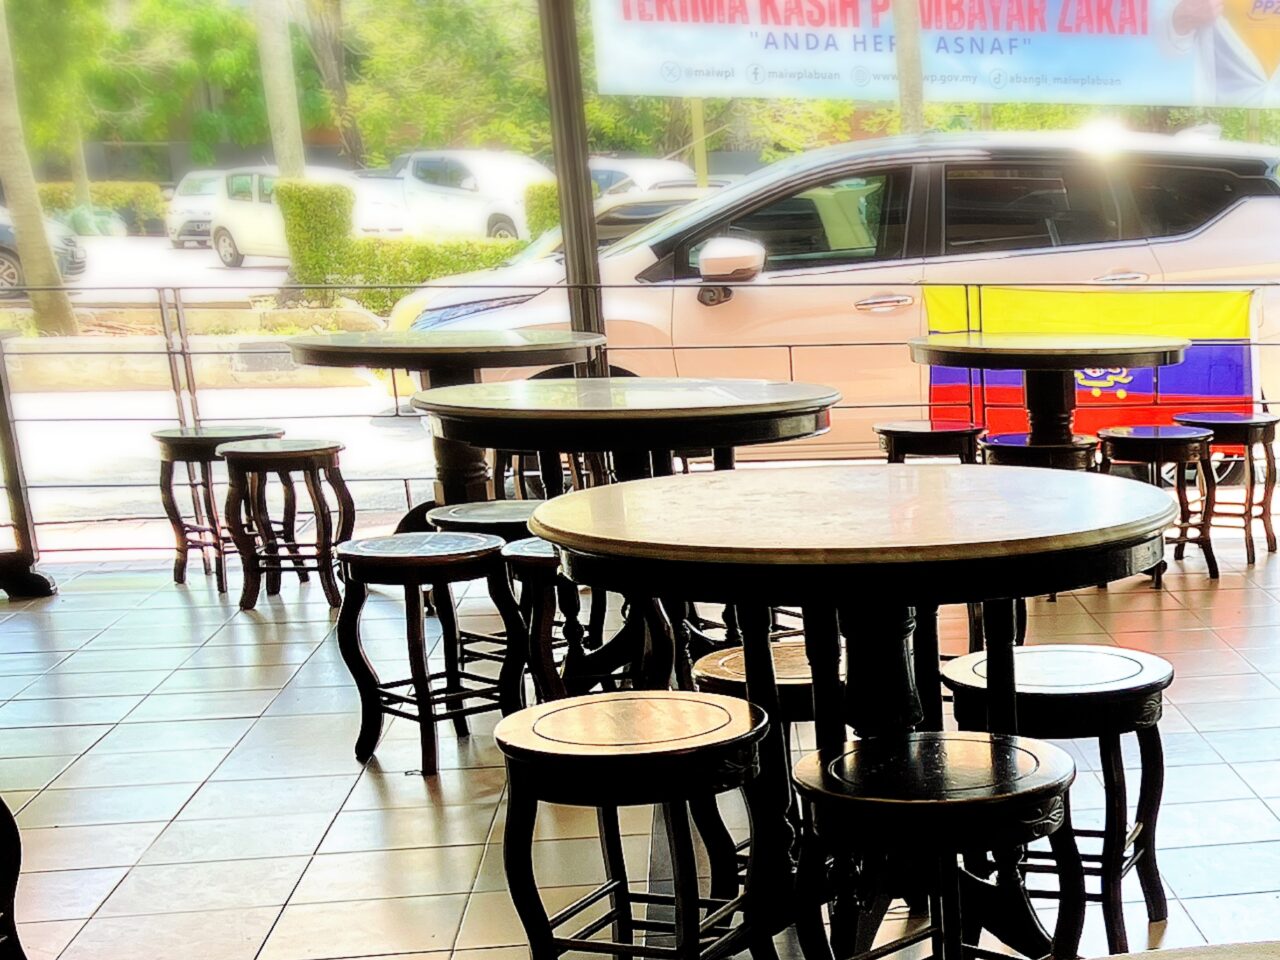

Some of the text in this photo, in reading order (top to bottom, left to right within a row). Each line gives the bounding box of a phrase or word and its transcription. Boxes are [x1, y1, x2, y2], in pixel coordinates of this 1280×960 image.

[760, 0, 860, 28] KASIH
[871, 0, 1048, 33] PMBAYAR
[935, 36, 1031, 56] ASNAF"
